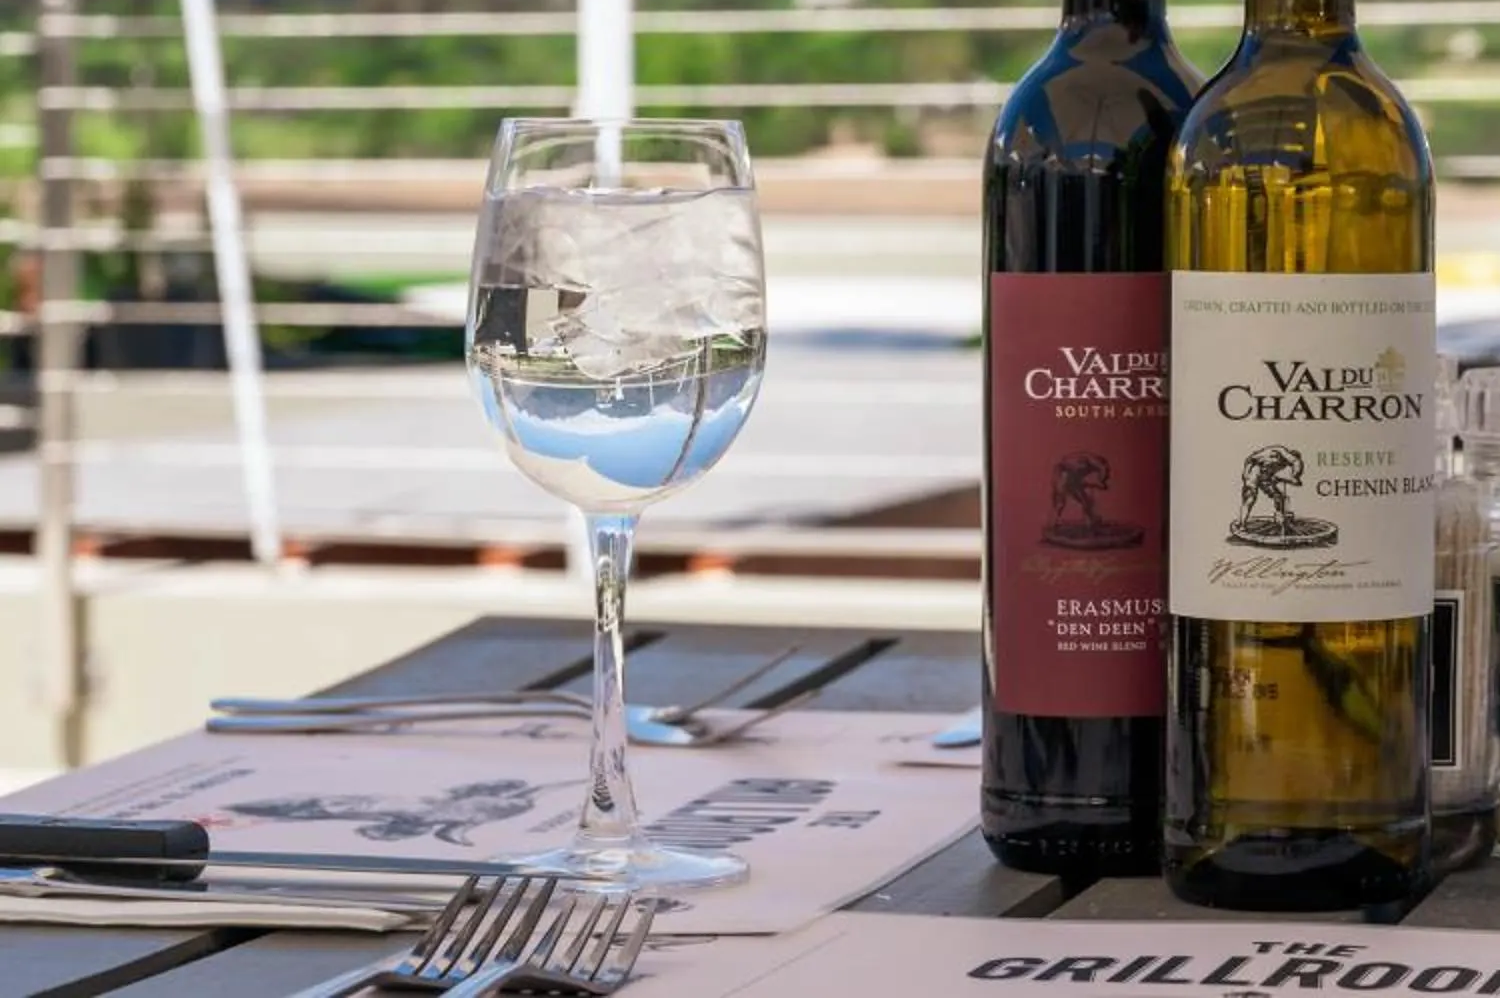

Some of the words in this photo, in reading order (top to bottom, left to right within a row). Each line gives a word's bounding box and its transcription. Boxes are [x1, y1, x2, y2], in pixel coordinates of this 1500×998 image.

[1297, 301, 1327, 315] AND
[1058, 347, 1131, 375] VAL
[1024, 368, 1163, 400] CHARR
[1263, 361, 1345, 392] VAL
[1339, 367, 1373, 388] DU
[1055, 405, 1115, 419] SOUTH
[1217, 385, 1424, 422] CHARRON
[1317, 451, 1394, 468] RESERVE
[1315, 478, 1398, 498] CHENIN
[1402, 473, 1434, 494] BLAN
[1057, 599, 1161, 616] ERASMUS
[1080, 641, 1108, 651] WINE
[1251, 941, 1368, 958] THE
